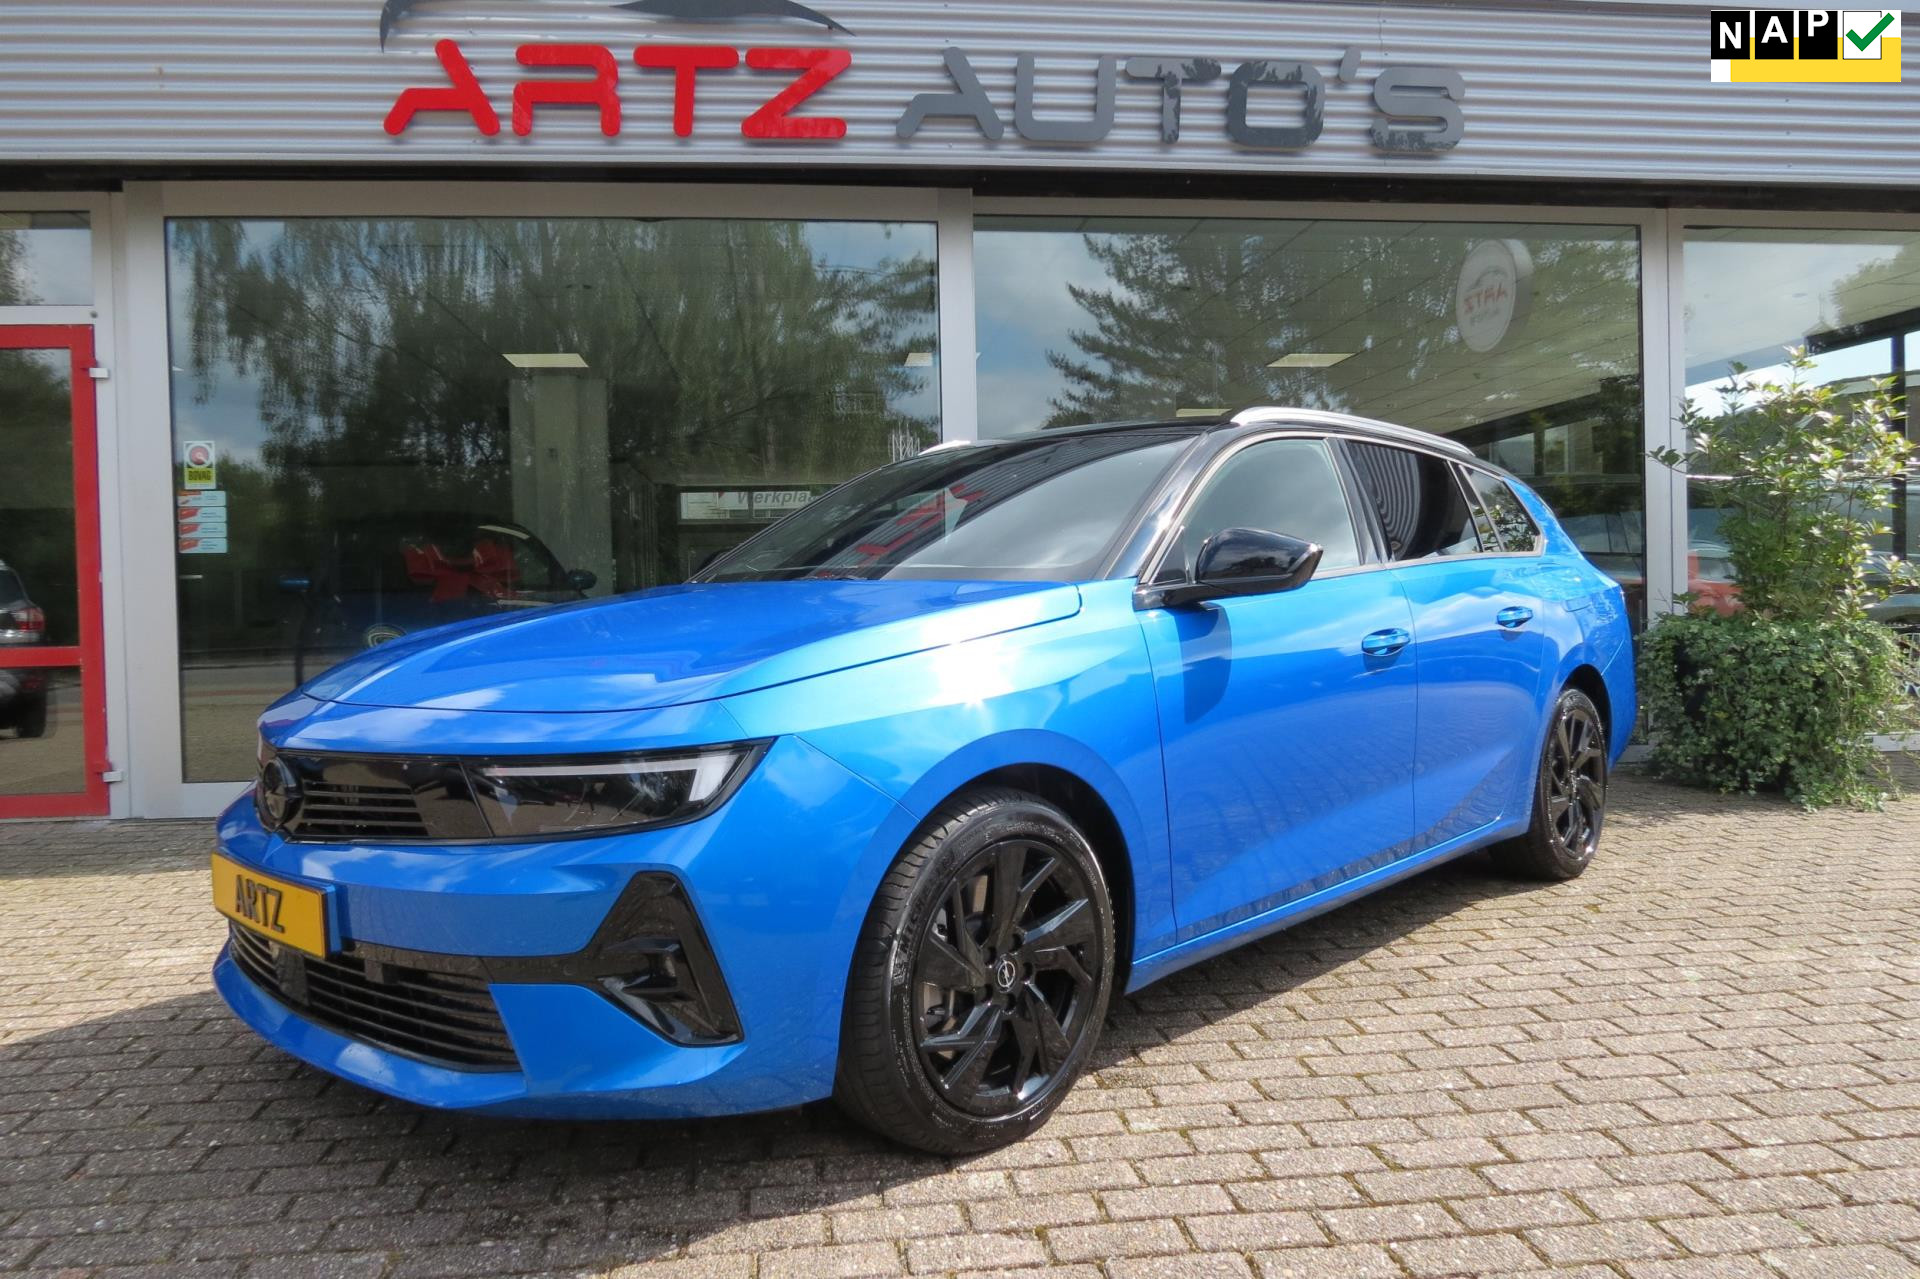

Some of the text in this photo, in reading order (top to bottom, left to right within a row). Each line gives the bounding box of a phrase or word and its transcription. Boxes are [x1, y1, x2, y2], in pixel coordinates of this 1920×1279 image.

[384, 39, 1465, 151] ARTZ AUTO'S
[236, 874, 286, 934] ARTZ
